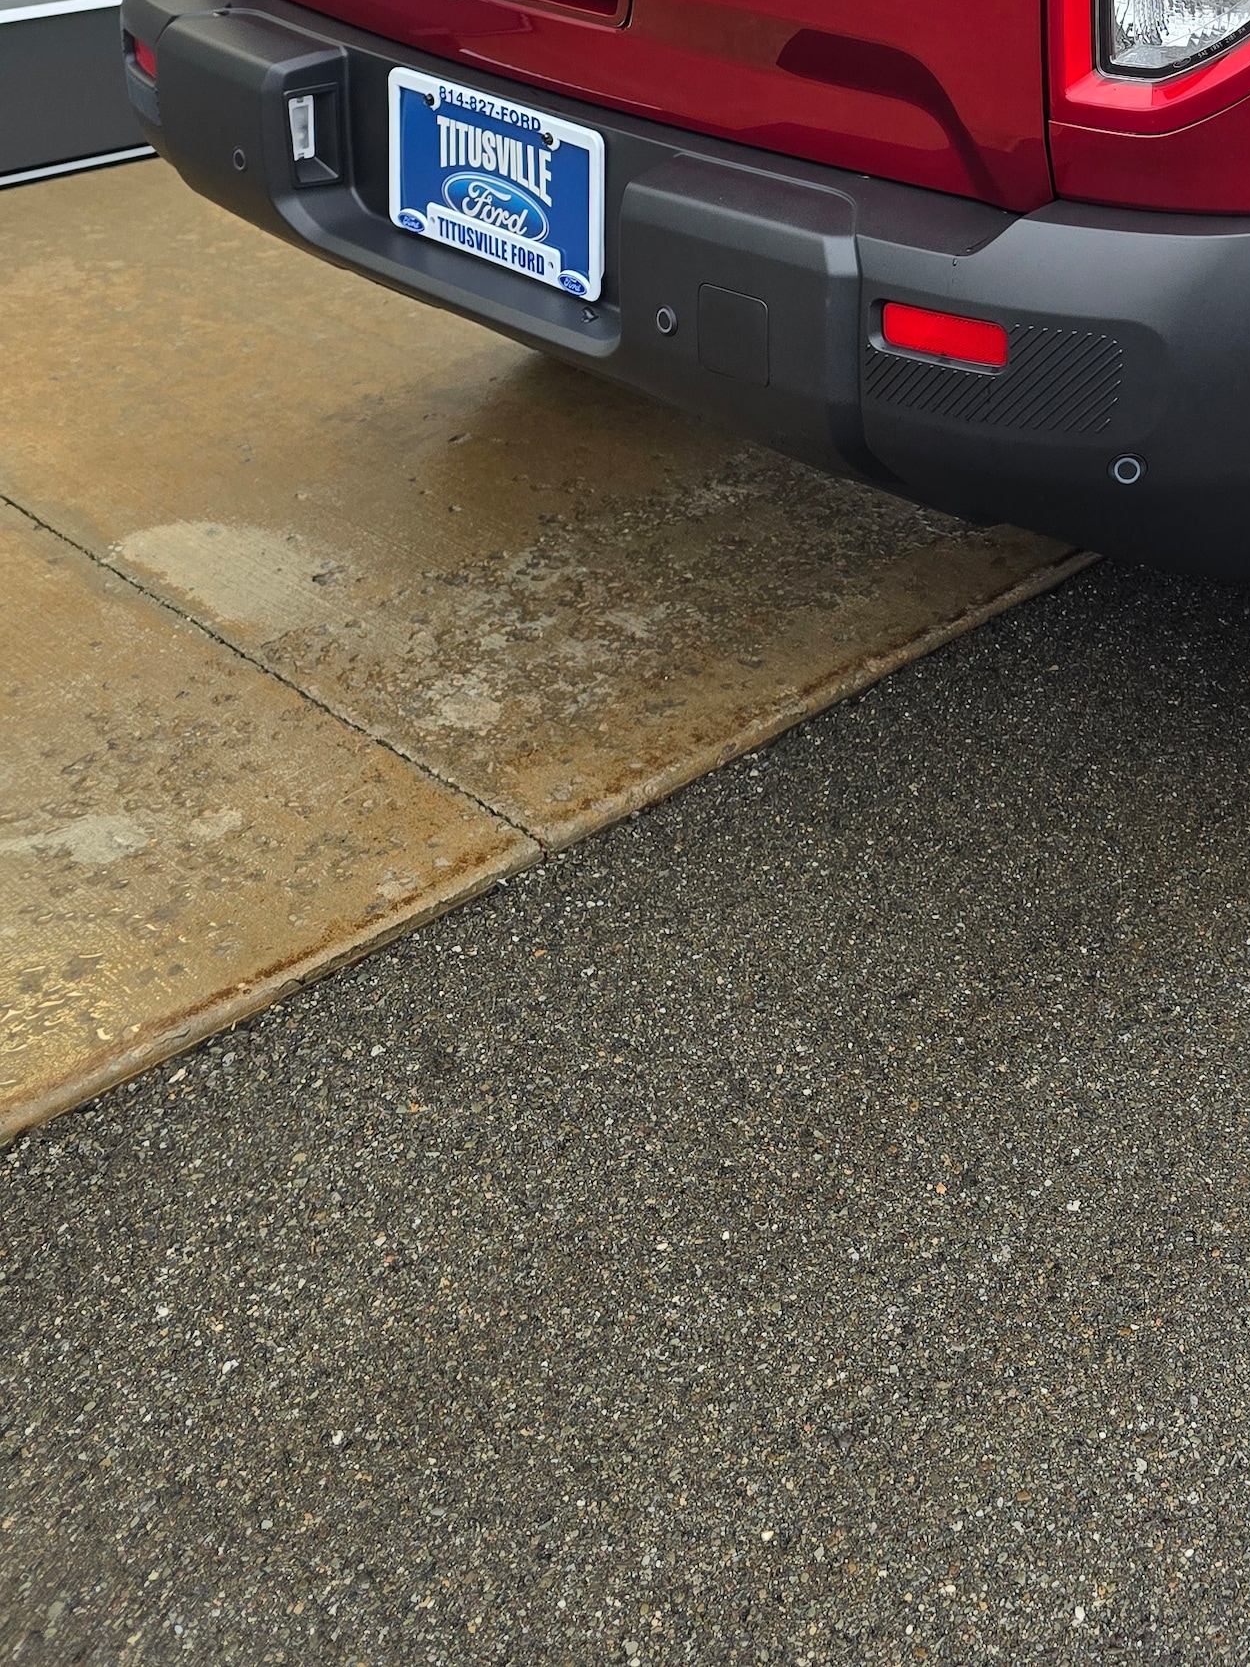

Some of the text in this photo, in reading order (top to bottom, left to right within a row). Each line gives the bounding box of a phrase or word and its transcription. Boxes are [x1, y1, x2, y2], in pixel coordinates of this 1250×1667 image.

[438, 85, 542, 132] 814-827-FORD
[436, 114, 552, 208] TITUSVILLE
[461, 180, 528, 237] Ford
[437, 216, 545, 276] TITUSVILLE FORD
